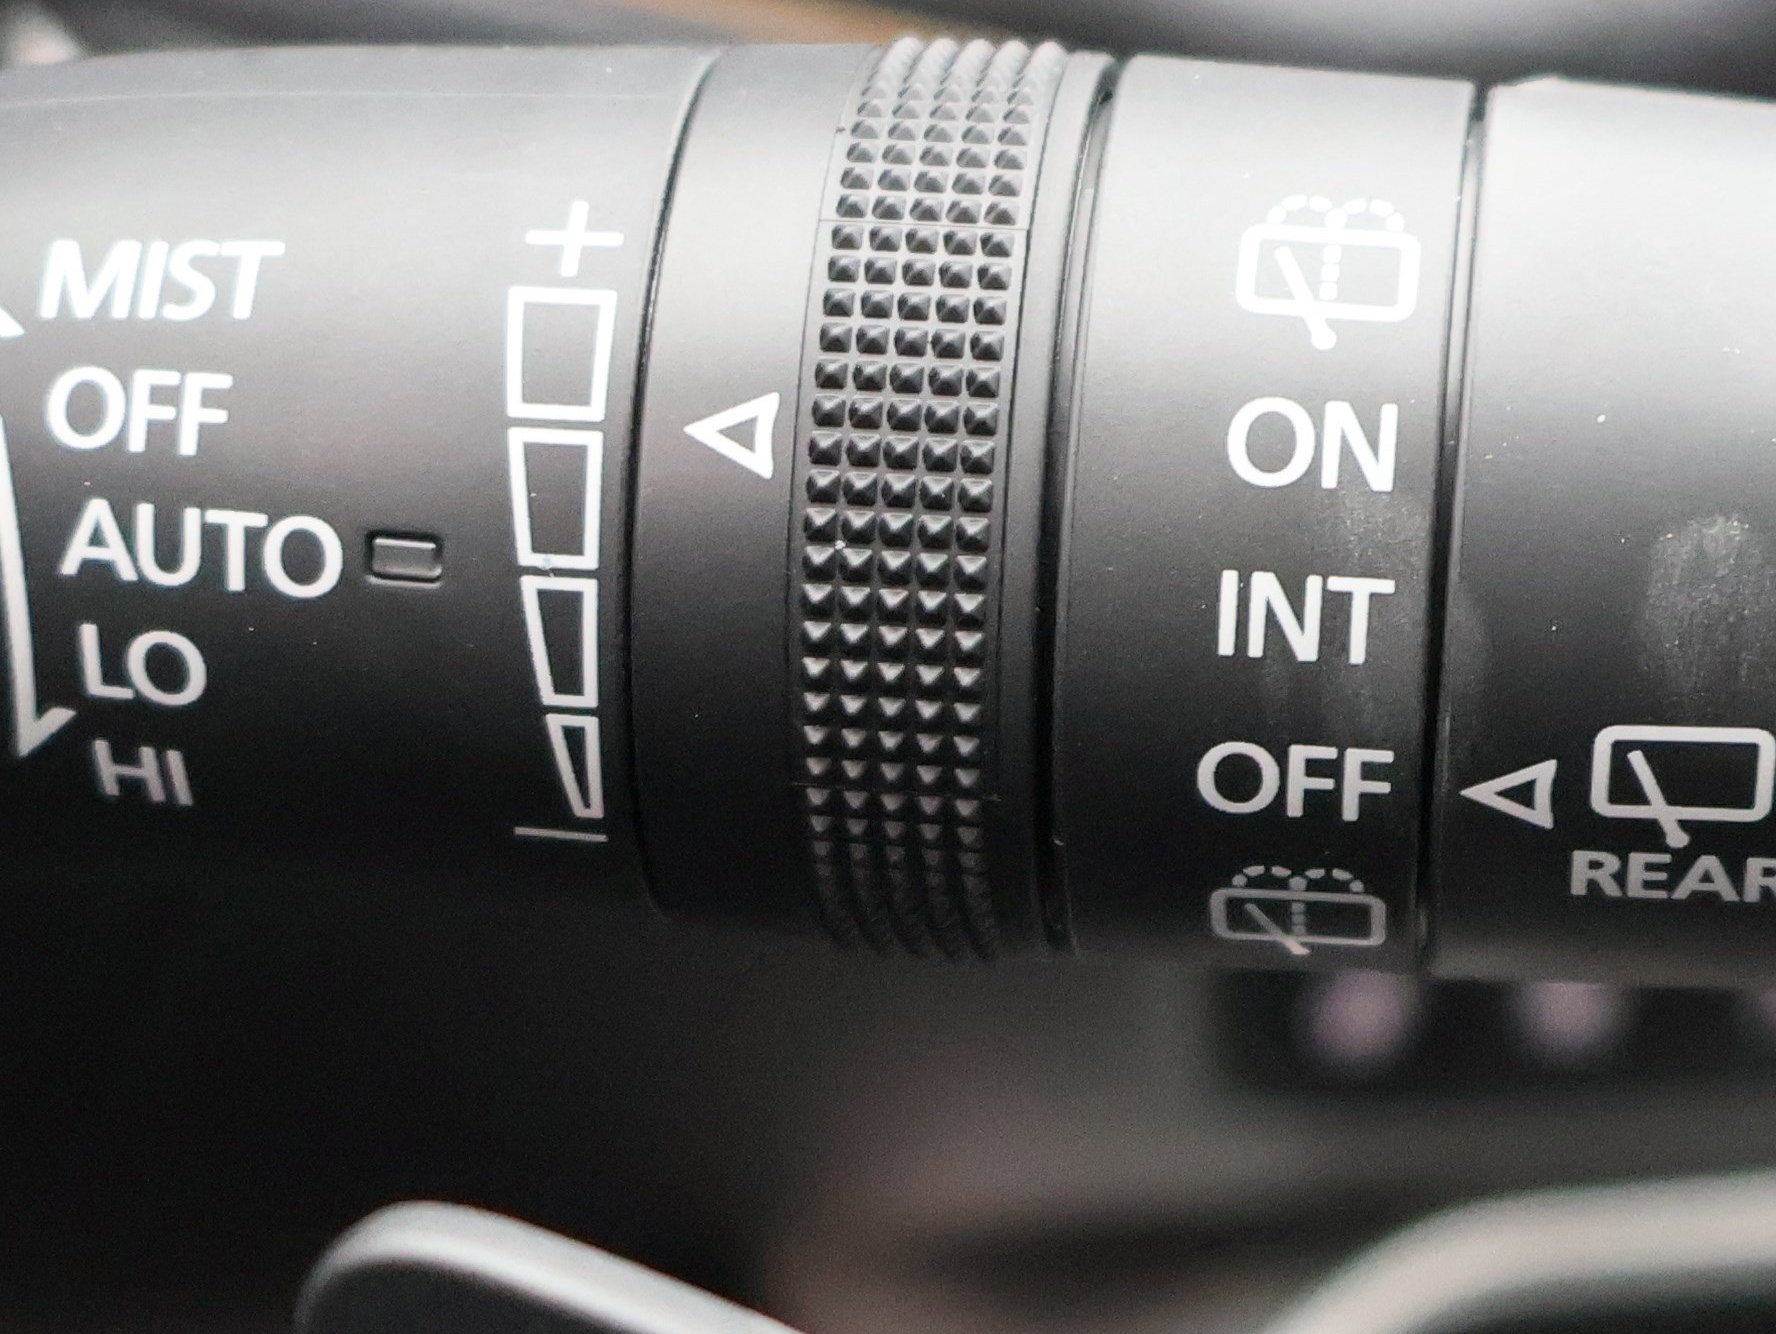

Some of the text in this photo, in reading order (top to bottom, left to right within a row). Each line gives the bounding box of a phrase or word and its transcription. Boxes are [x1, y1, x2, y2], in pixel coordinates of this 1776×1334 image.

[39, 241, 285, 320] MIST
[46, 366, 233, 456] OFF
[1227, 396, 1399, 492] ON
[61, 499, 344, 598] AUTO
[1217, 570, 1396, 664] INT
[79, 623, 208, 706] LO
[92, 739, 194, 806] HI
[1197, 741, 1395, 822] OFF
